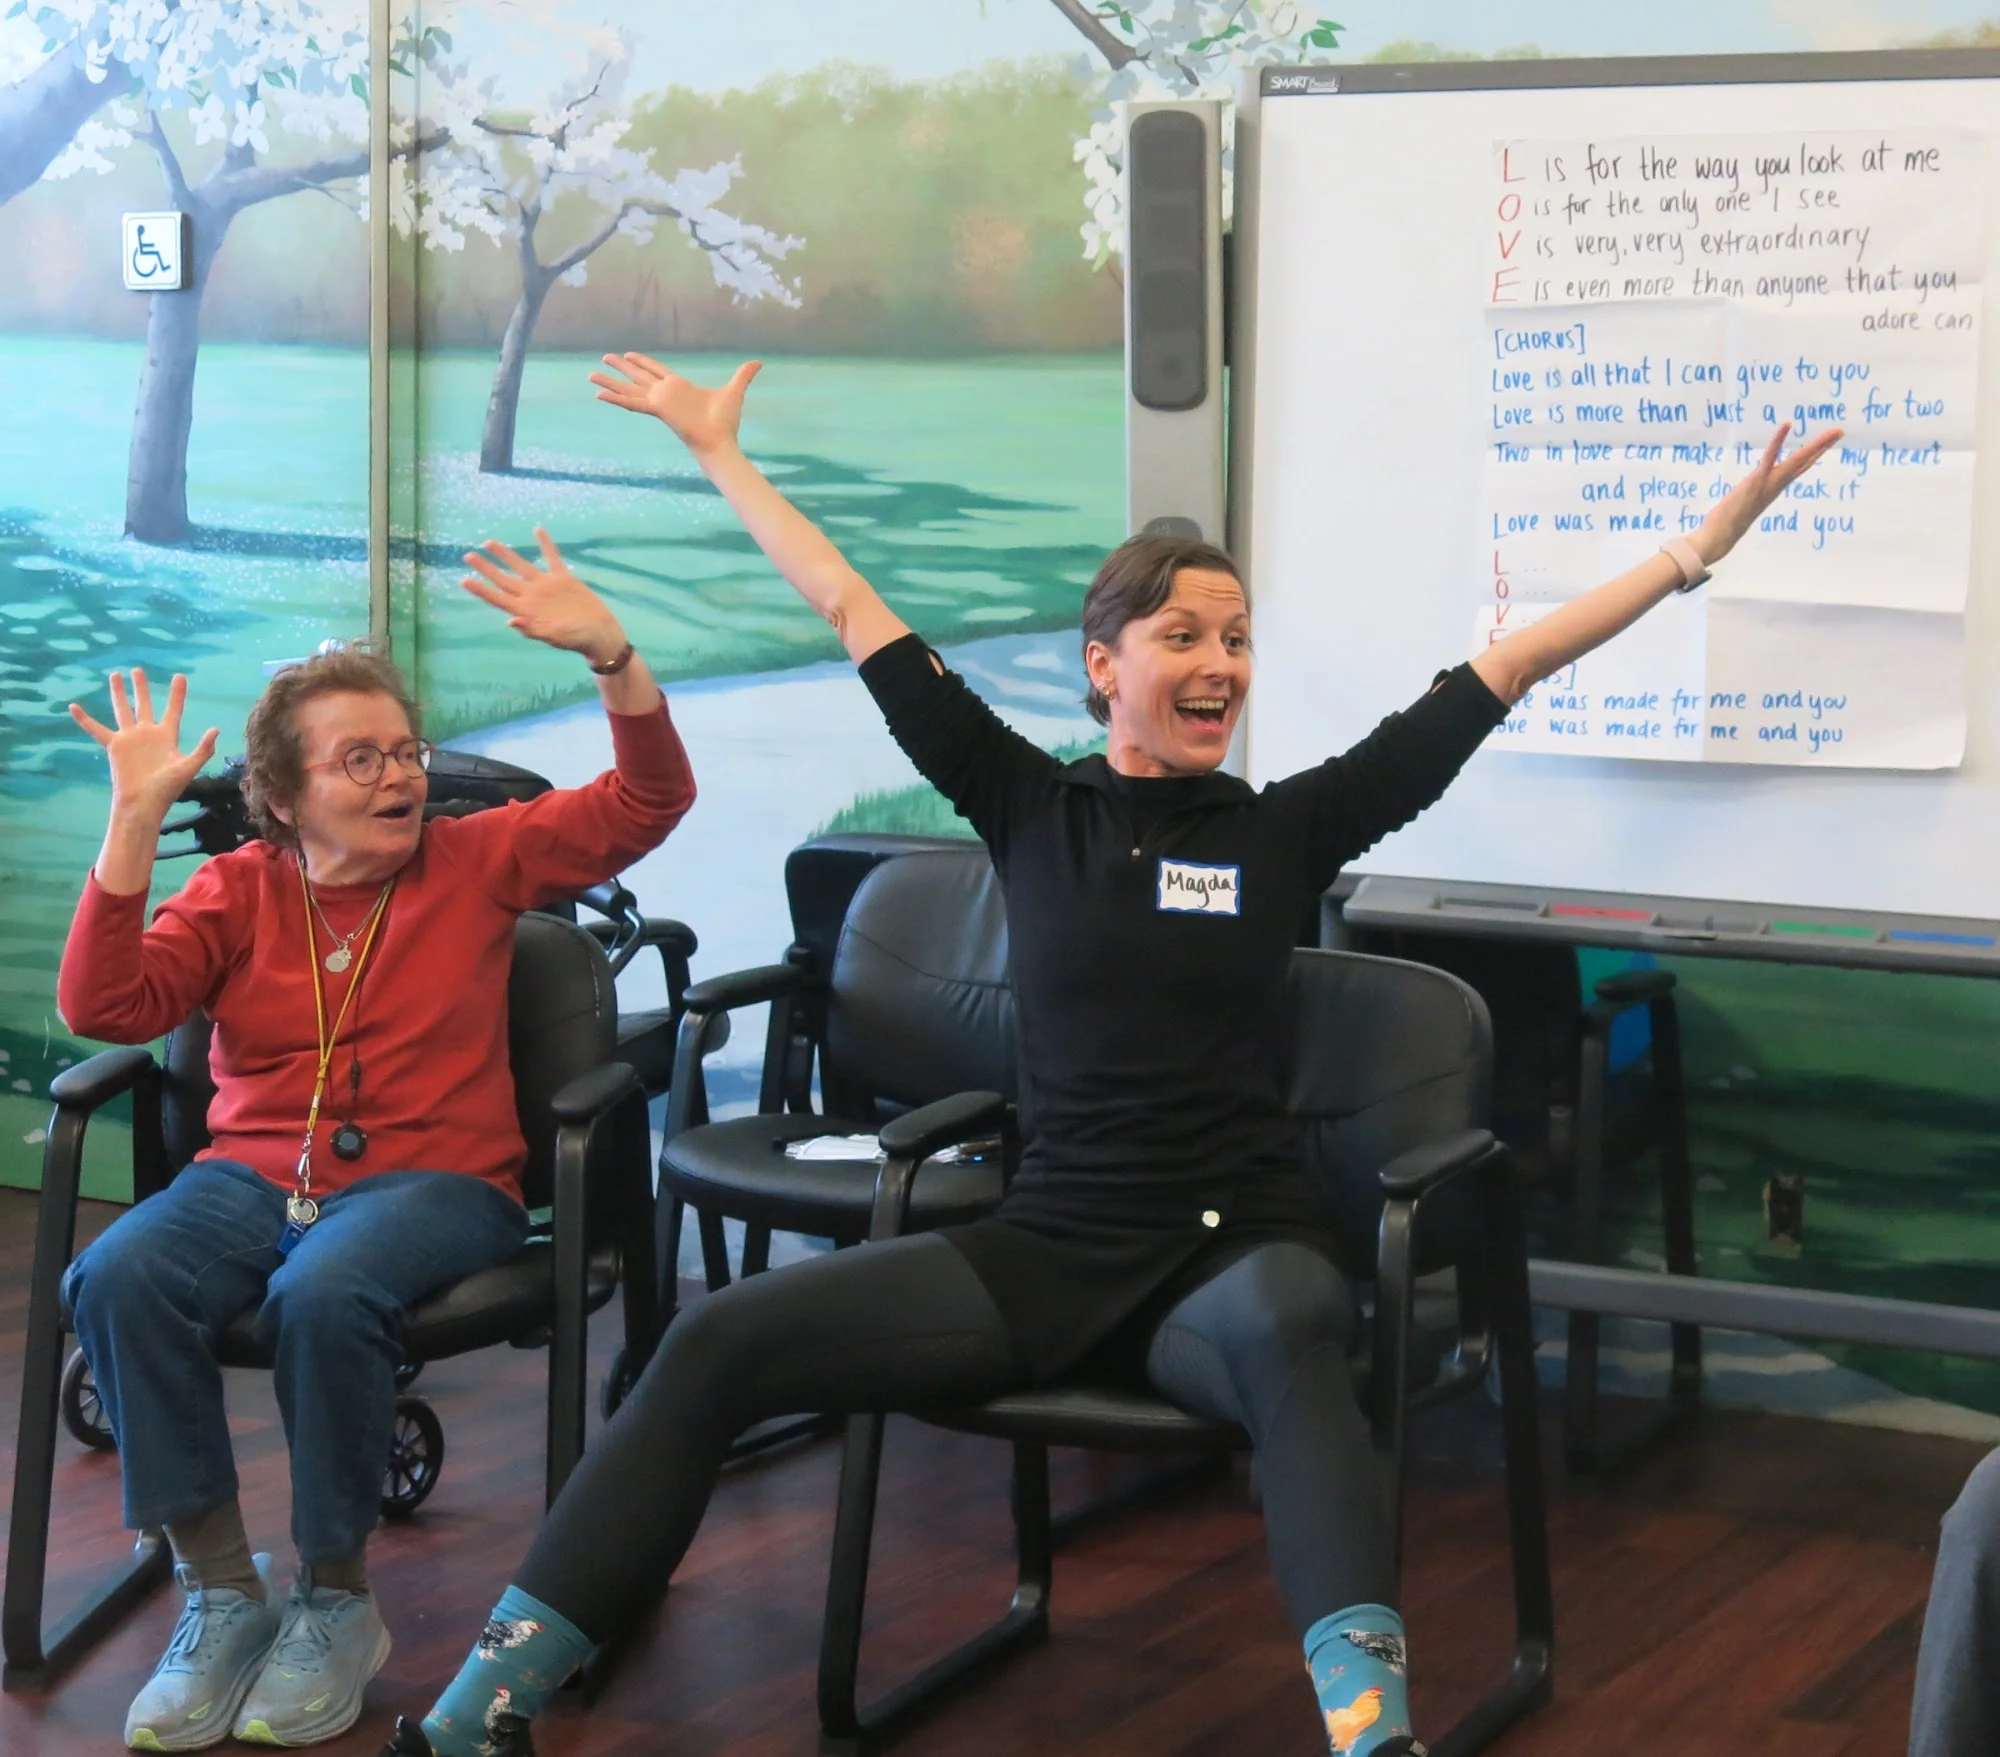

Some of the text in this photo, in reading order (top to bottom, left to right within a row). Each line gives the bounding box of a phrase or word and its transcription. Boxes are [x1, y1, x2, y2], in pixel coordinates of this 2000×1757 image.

[1270, 76, 1307, 89] SMART
[1503, 139, 1941, 195] L is for the way you look at me
[1498, 186, 1841, 230] O is for the only one I see
[1498, 229, 1522, 260] V
[1536, 235, 1554, 259] is
[1700, 222, 1870, 263] extraordinary
[1492, 264, 1957, 307] E is even more than anyone that you
[1862, 307, 1973, 332] adore can
[1494, 323, 1586, 360] [CHORUS]
[1492, 355, 1871, 398] Love is all that I can give to you
[1493, 386, 1945, 437] Love is more than just a game for two
[1494, 442, 1530, 463] Two
[1546, 441, 1563, 461] in
[1572, 439, 1614, 465] love
[1624, 444, 1662, 461] can
[1672, 441, 1724, 466] make
[1840, 446, 1870, 478] my
[1881, 440, 1941, 466] heart
[1582, 474, 1626, 503] and
[1639, 475, 1698, 504] please
[1785, 478, 1831, 499] reak
[1840, 480, 1861, 500] it
[1493, 512, 1539, 540] Love
[1555, 513, 1594, 532] was
[1609, 508, 1666, 533] made
[1760, 510, 1798, 533] and
[1813, 514, 1854, 549] you
[1495, 550, 1511, 575] L
[1495, 578, 1509, 600] O
[1496, 603, 1511, 626] V
[1550, 694, 1588, 710] was
[1604, 692, 1659, 710] made
[1672, 688, 1701, 715] for
[1710, 692, 1746, 709] me
[1762, 689, 1803, 709] and
[1809, 693, 1847, 719] you
[1491, 718, 1843, 753] ove was made for me and you
[1167, 870, 1238, 908] Magda
